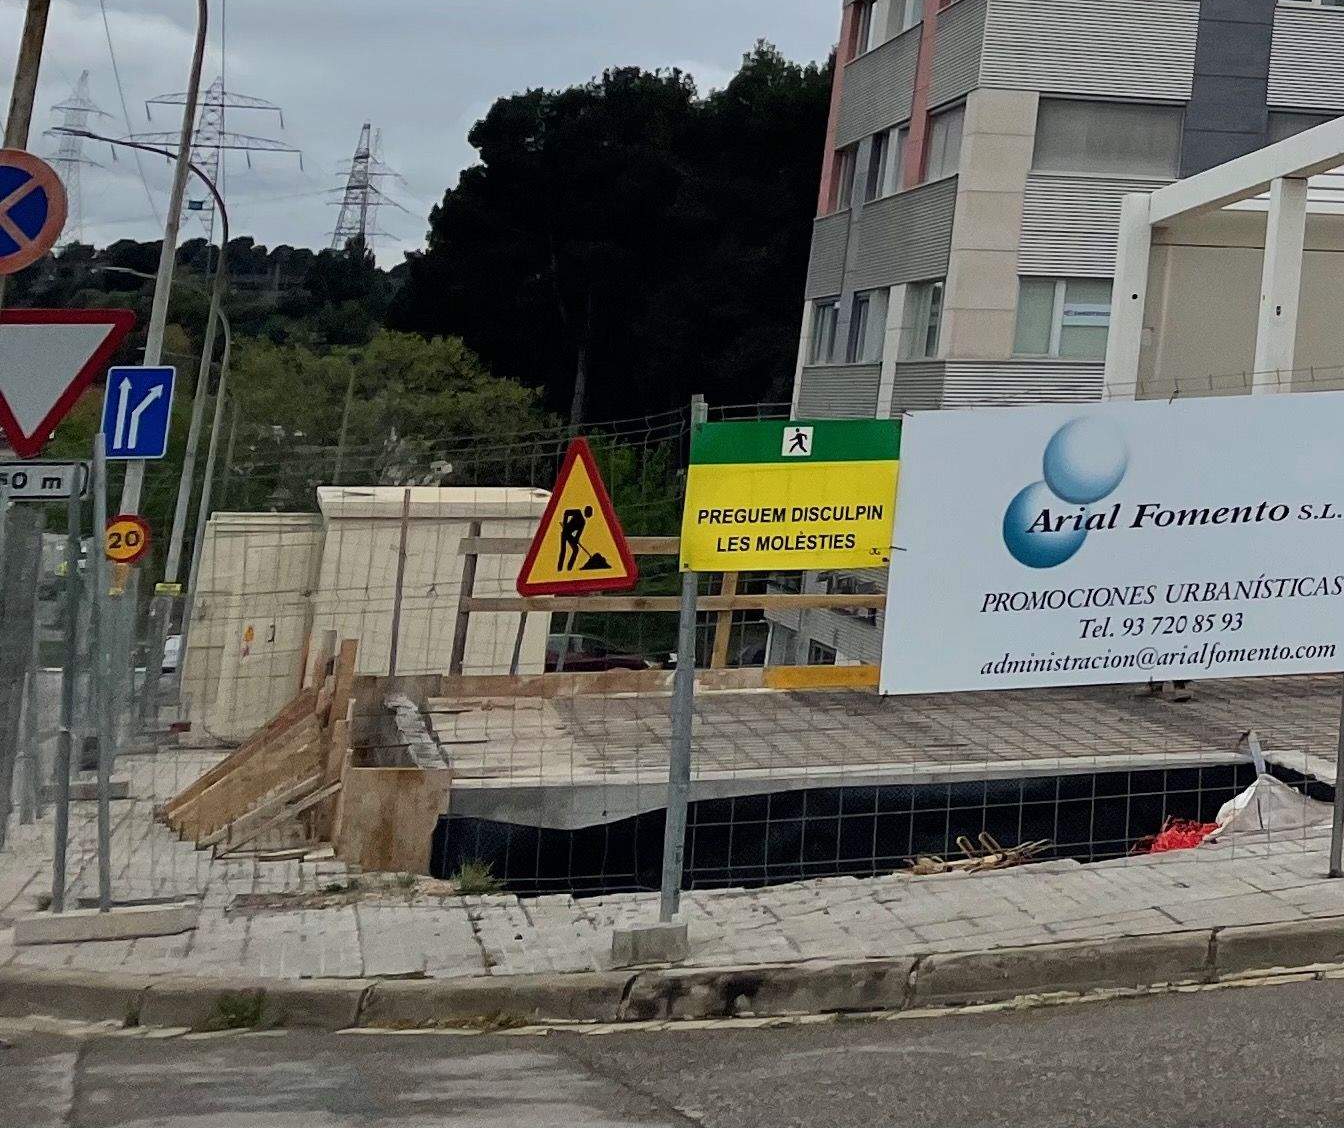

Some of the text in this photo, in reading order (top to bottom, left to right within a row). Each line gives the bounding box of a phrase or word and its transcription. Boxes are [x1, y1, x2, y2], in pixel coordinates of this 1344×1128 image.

[41, 477, 61, 489] m
[698, 505, 884, 524] PREGUEM DISCULPIN
[1025, 501, 1343, 533] Arial Fomento S.L.
[108, 531, 140, 549] 20
[717, 536, 750, 553] LES
[755, 531, 856, 552] MOLÈSTIES
[980, 573, 1344, 614] PROMOCIONES URBANÍSTICAS
[1079, 612, 1243, 639] Tel. 93 720 85 93
[980, 641, 1336, 675] administracion@arialfomento.com
